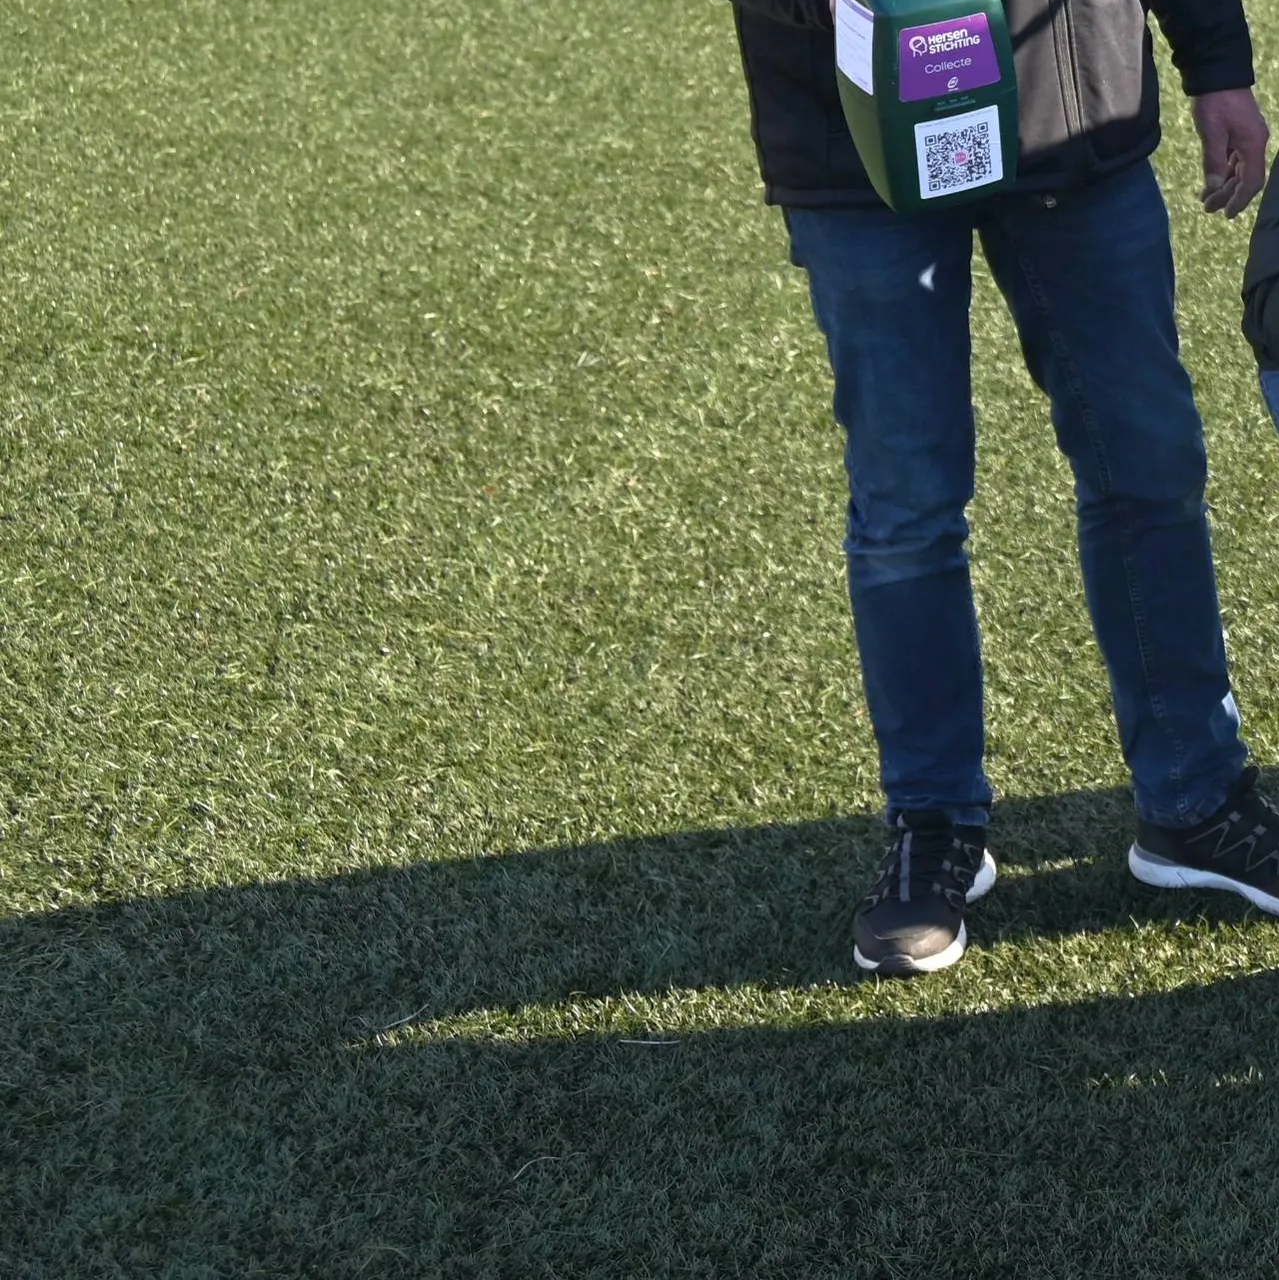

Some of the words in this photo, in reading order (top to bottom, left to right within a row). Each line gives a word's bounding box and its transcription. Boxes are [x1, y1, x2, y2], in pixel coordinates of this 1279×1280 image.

[927, 28, 968, 46] Hersen
[929, 35, 981, 55] STICHTING
[924, 56, 972, 74] Collecte
